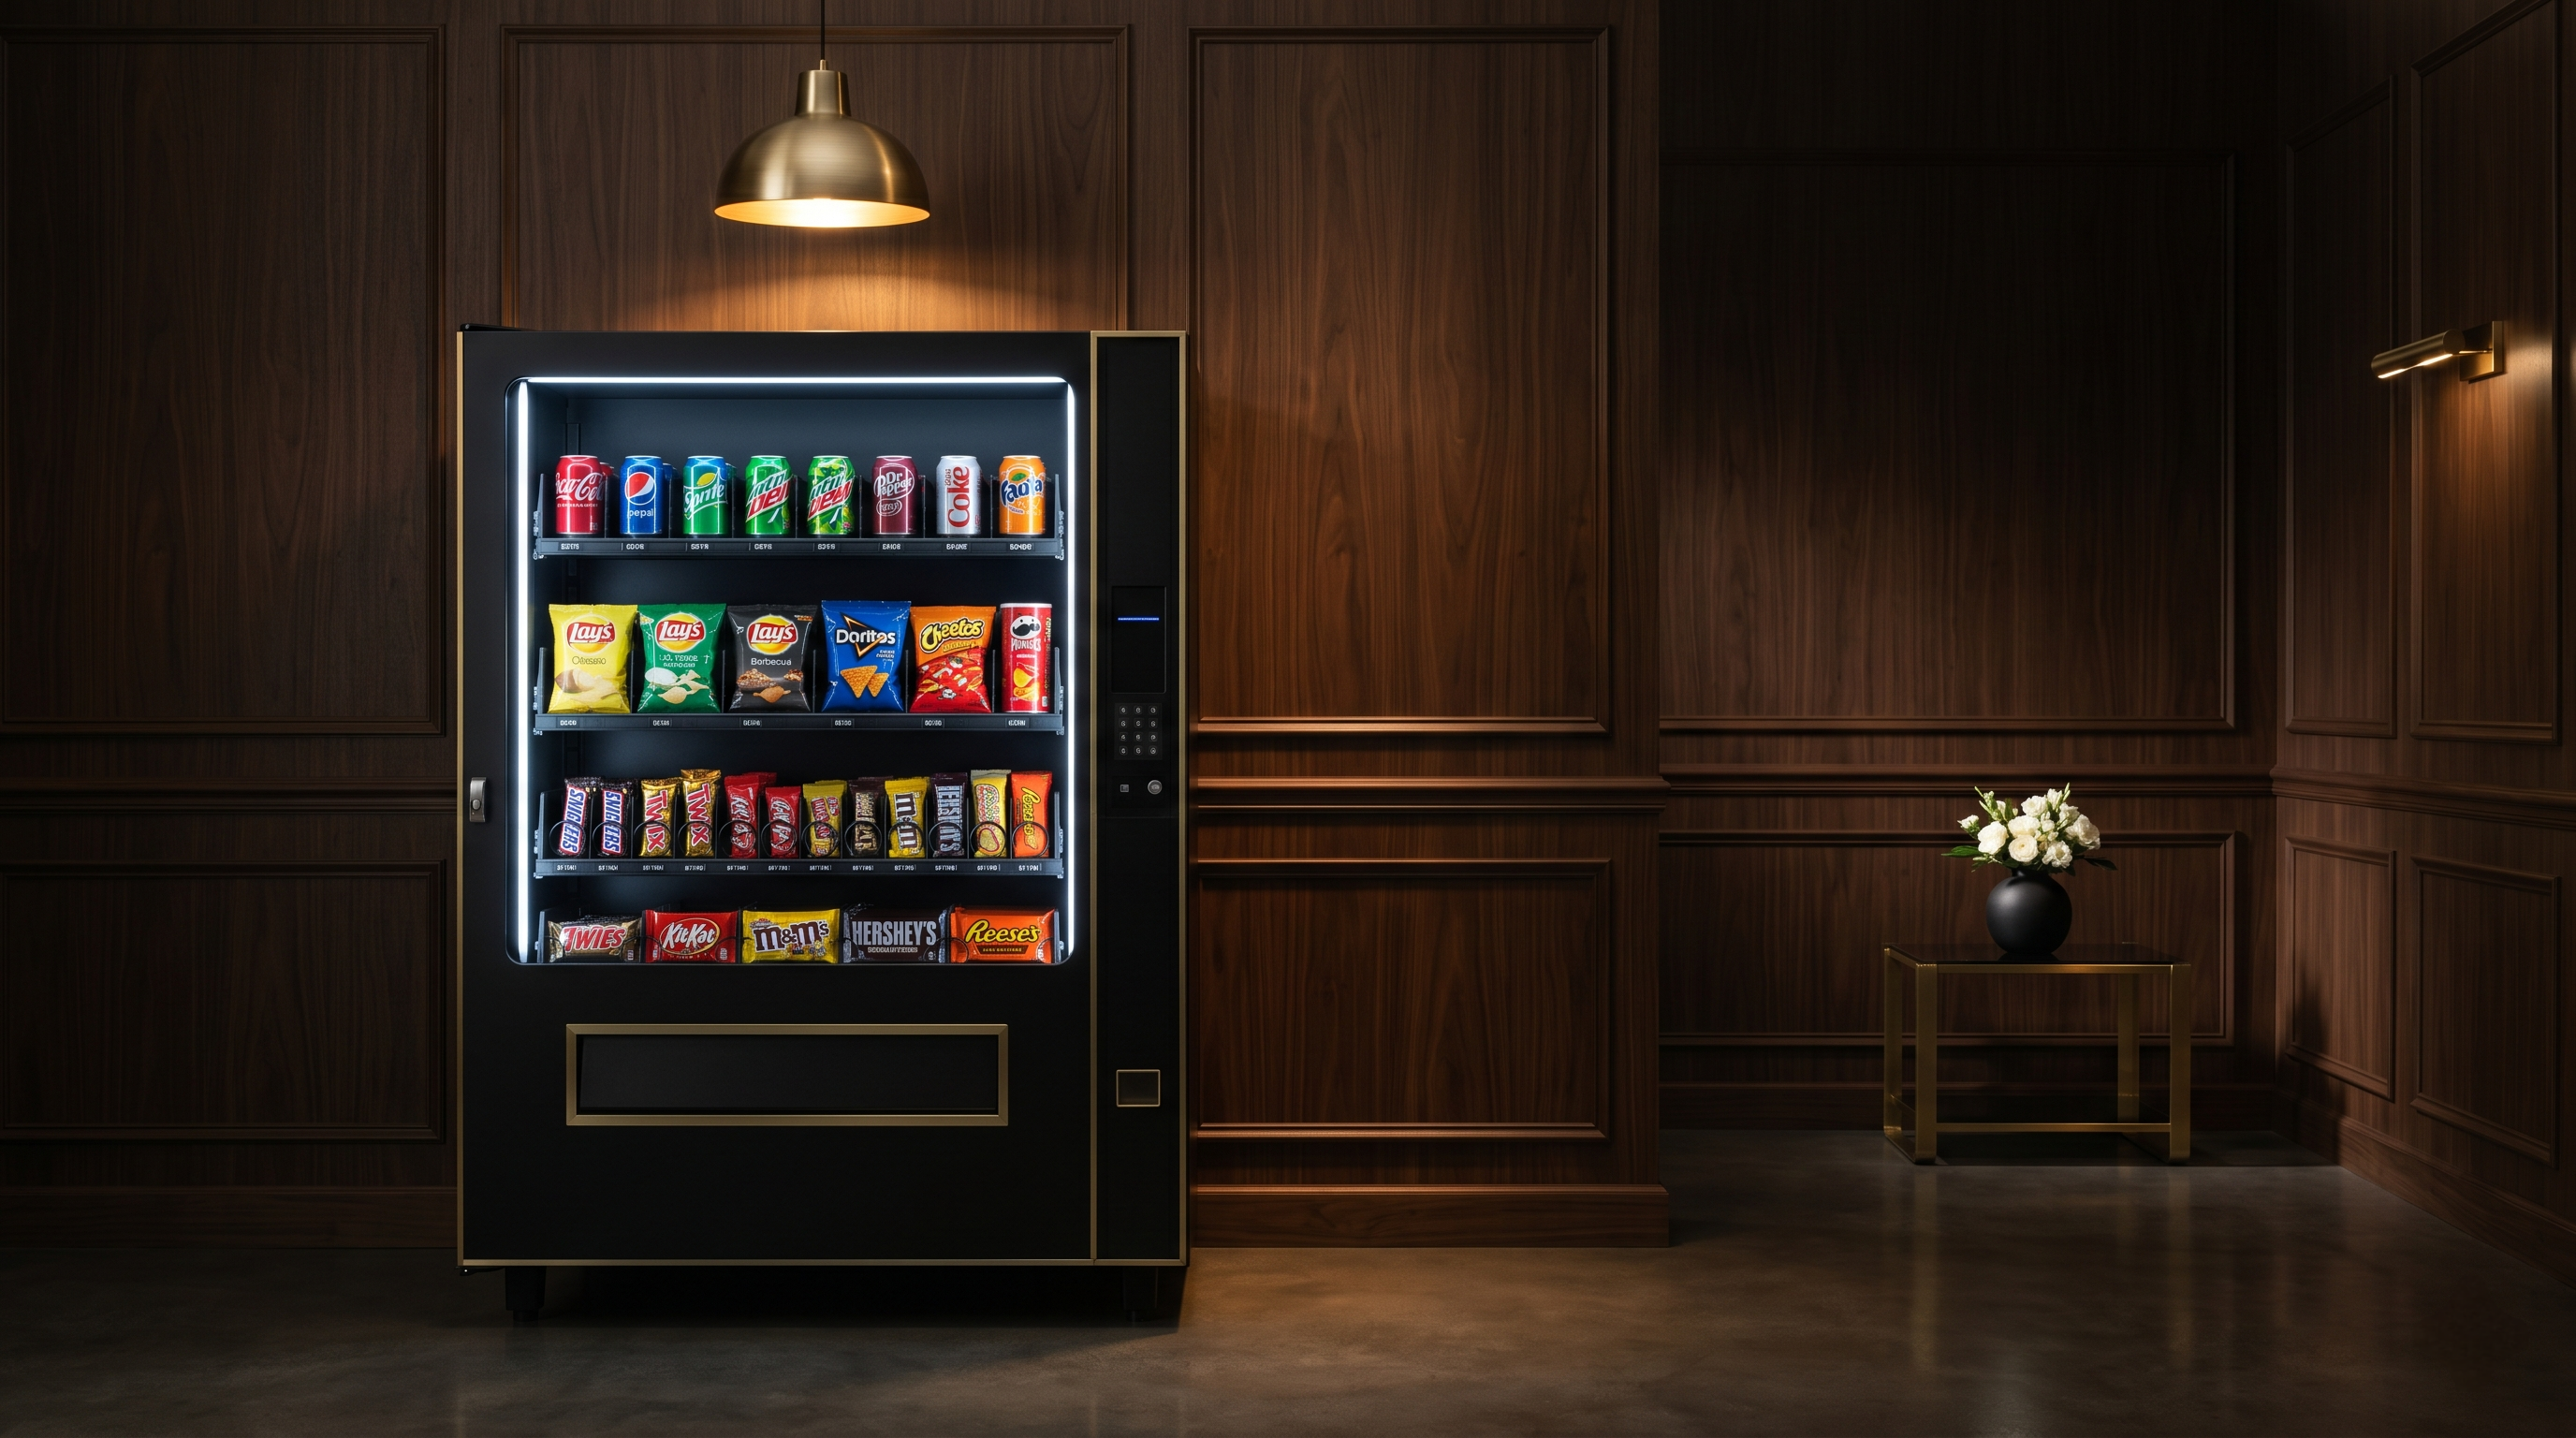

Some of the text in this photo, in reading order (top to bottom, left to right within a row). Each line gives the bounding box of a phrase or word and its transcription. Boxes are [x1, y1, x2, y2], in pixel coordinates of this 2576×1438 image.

[947, 466, 970, 528] Coke
[646, 789, 668, 853] TWIX
[853, 920, 936, 946] HERSHEY'S
[965, 920, 1042, 944] Reese's
